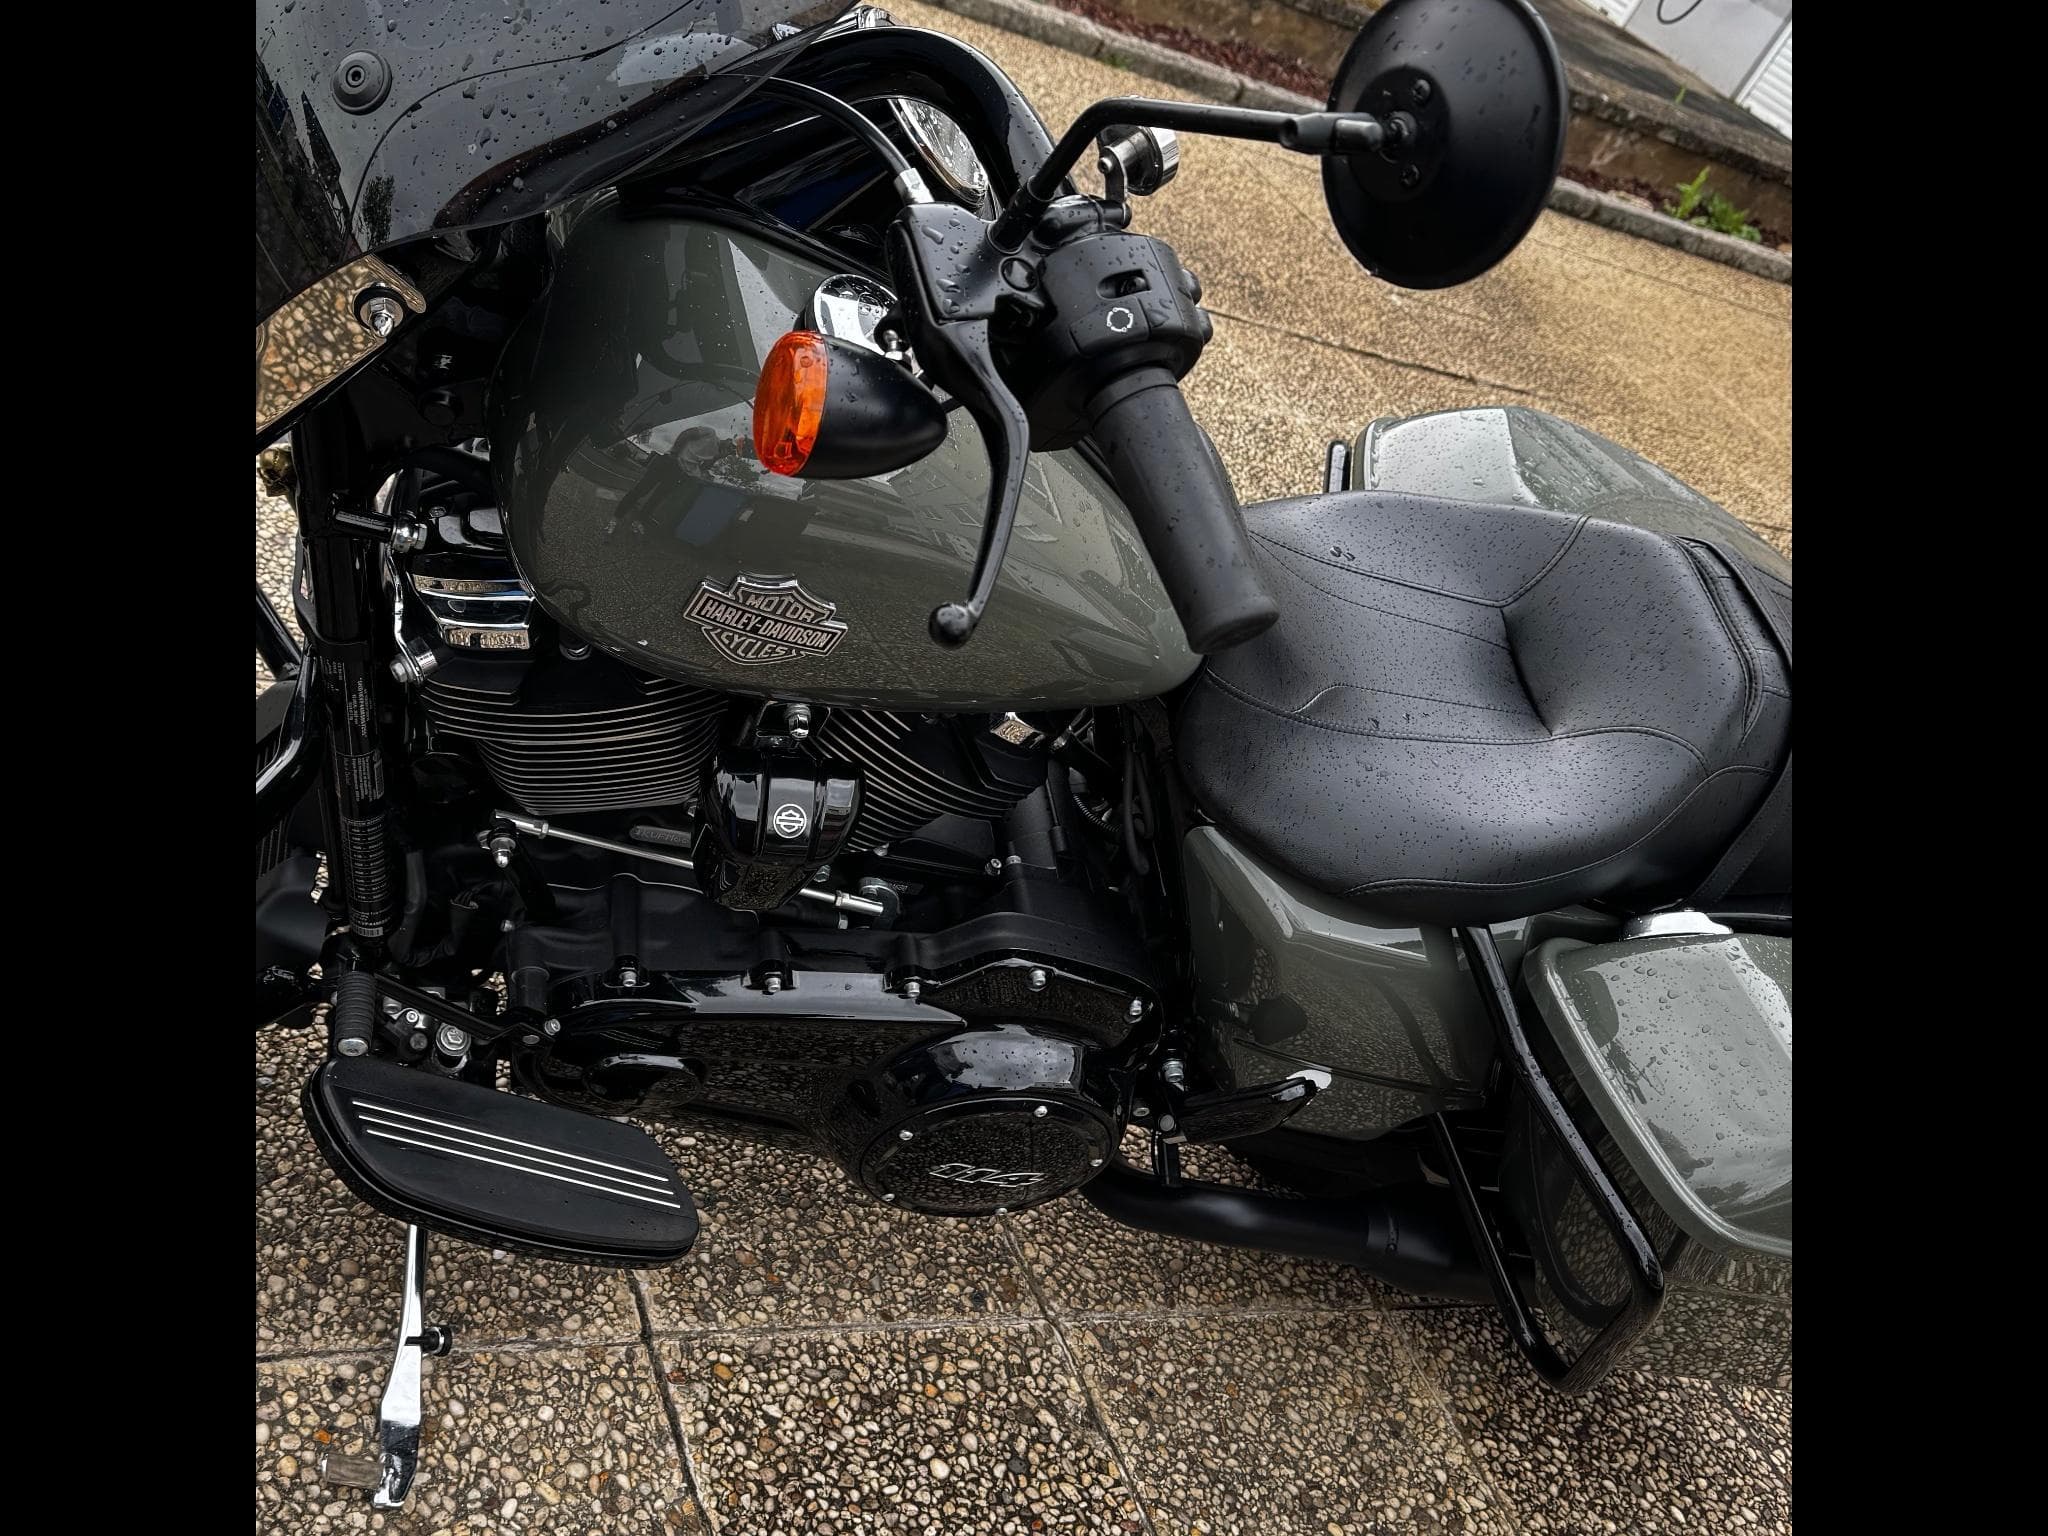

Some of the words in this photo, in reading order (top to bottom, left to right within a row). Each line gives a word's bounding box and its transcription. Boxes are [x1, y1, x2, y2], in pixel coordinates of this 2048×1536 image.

[700, 598, 833, 648] HARLEY-DAVIDSON
[745, 594, 815, 623] MOTOR
[720, 630, 788, 659] CYCLES
[928, 1162, 1046, 1188] 114
